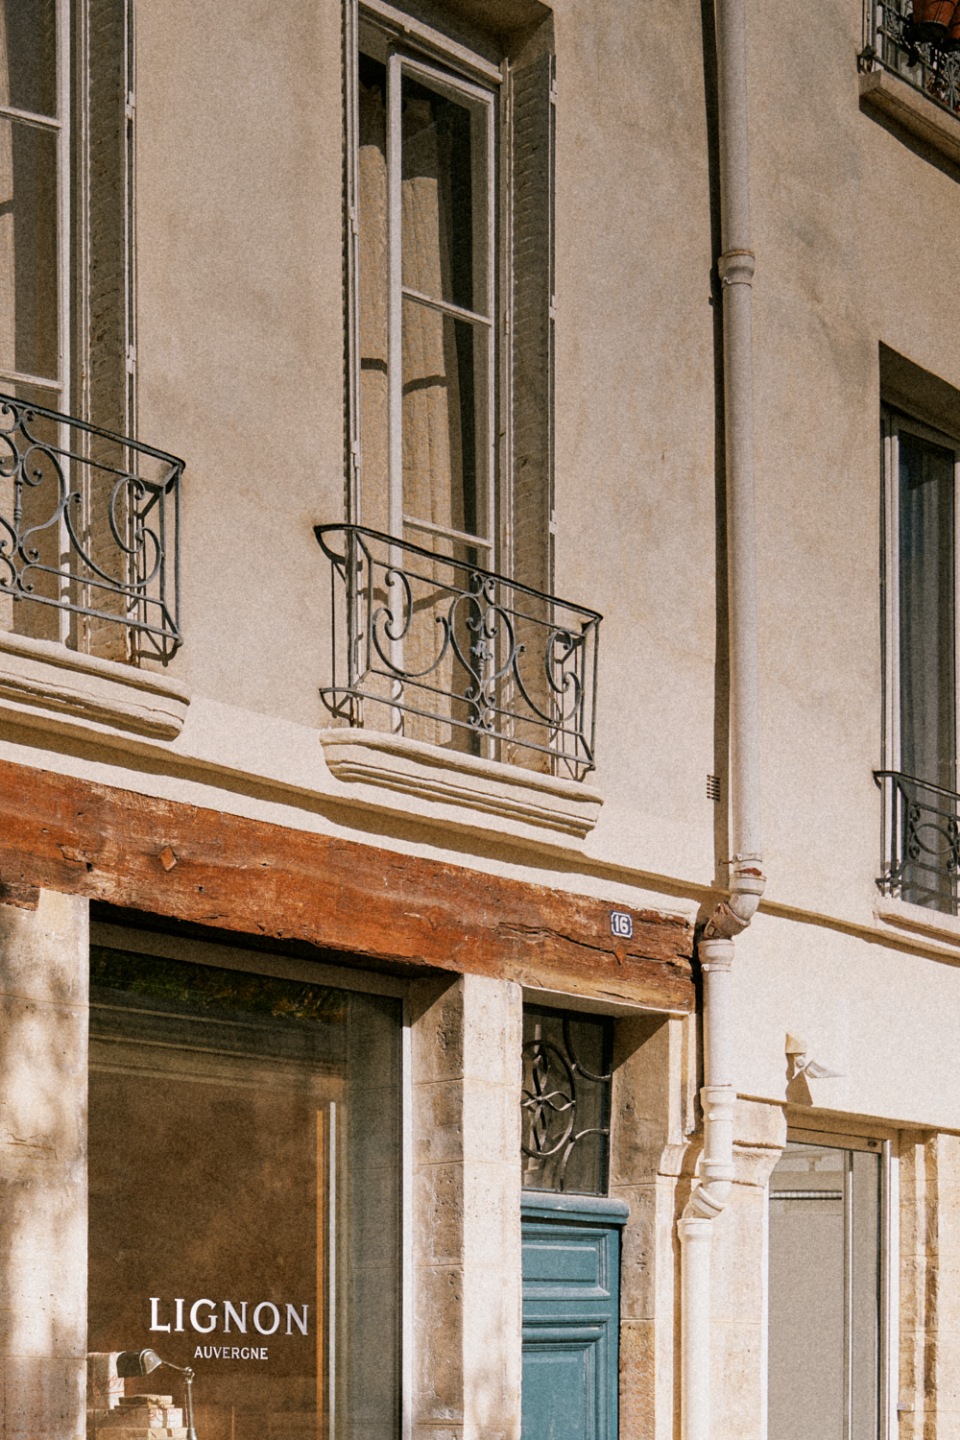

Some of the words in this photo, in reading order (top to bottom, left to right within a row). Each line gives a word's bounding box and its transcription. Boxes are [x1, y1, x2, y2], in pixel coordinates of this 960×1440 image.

[614, 915, 630, 934] 16
[148, 1297, 309, 1336] LIGNON
[194, 1345, 269, 1360] AUVERGNE
